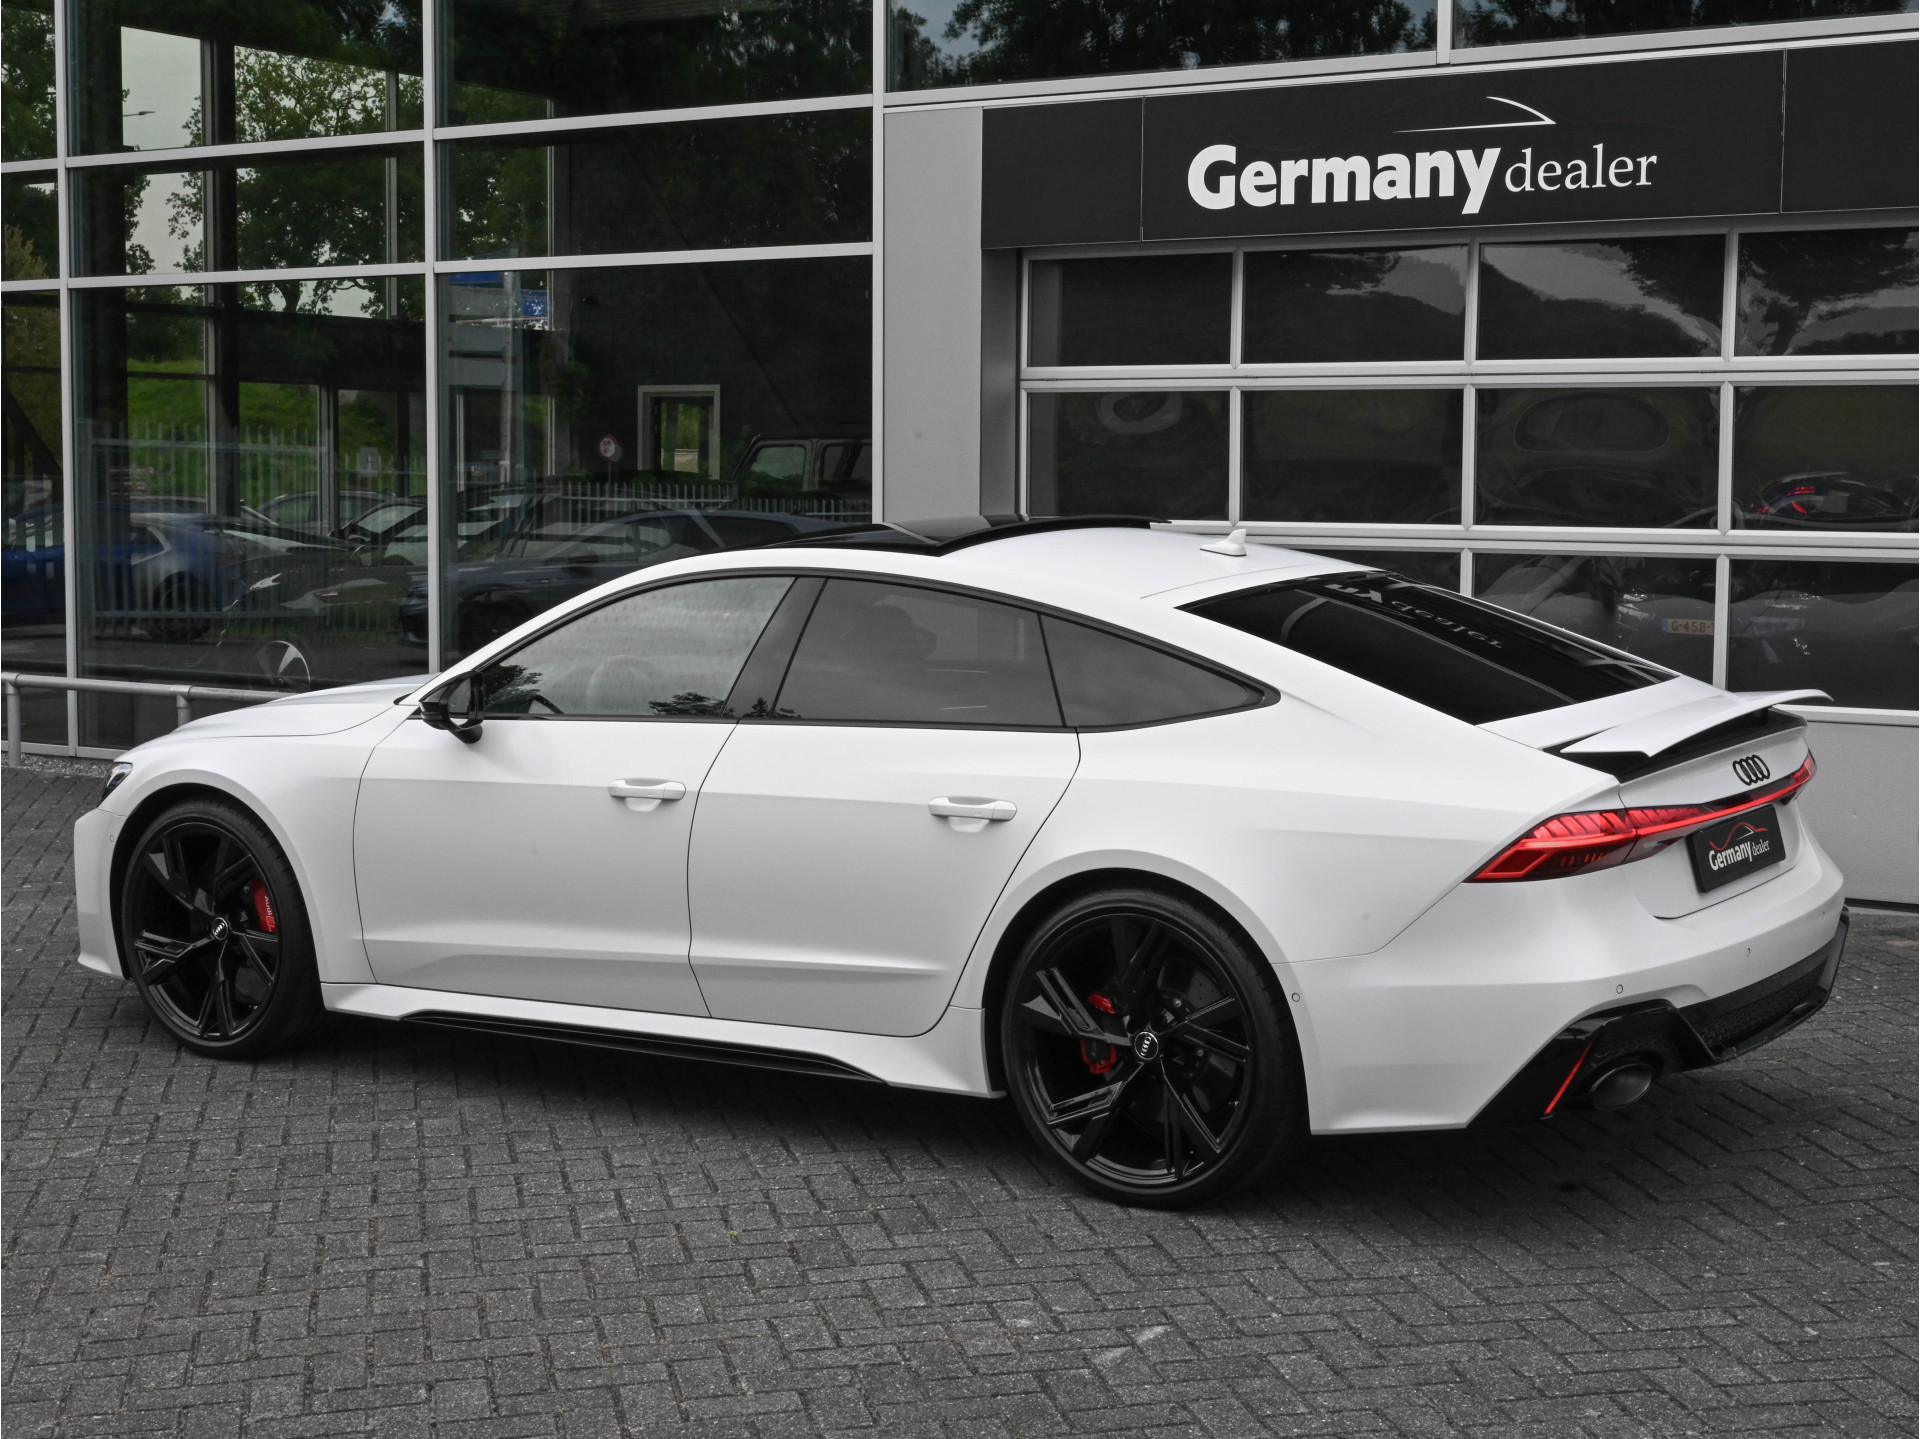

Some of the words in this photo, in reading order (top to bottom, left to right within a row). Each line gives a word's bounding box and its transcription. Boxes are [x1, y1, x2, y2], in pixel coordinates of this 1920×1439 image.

[1187, 144, 1501, 215] Germany
[1504, 143, 1657, 193] dealer
[1709, 841, 1752, 871] Germany
[1752, 839, 1770, 856] dealer
[264, 895, 273, 916] Audi
